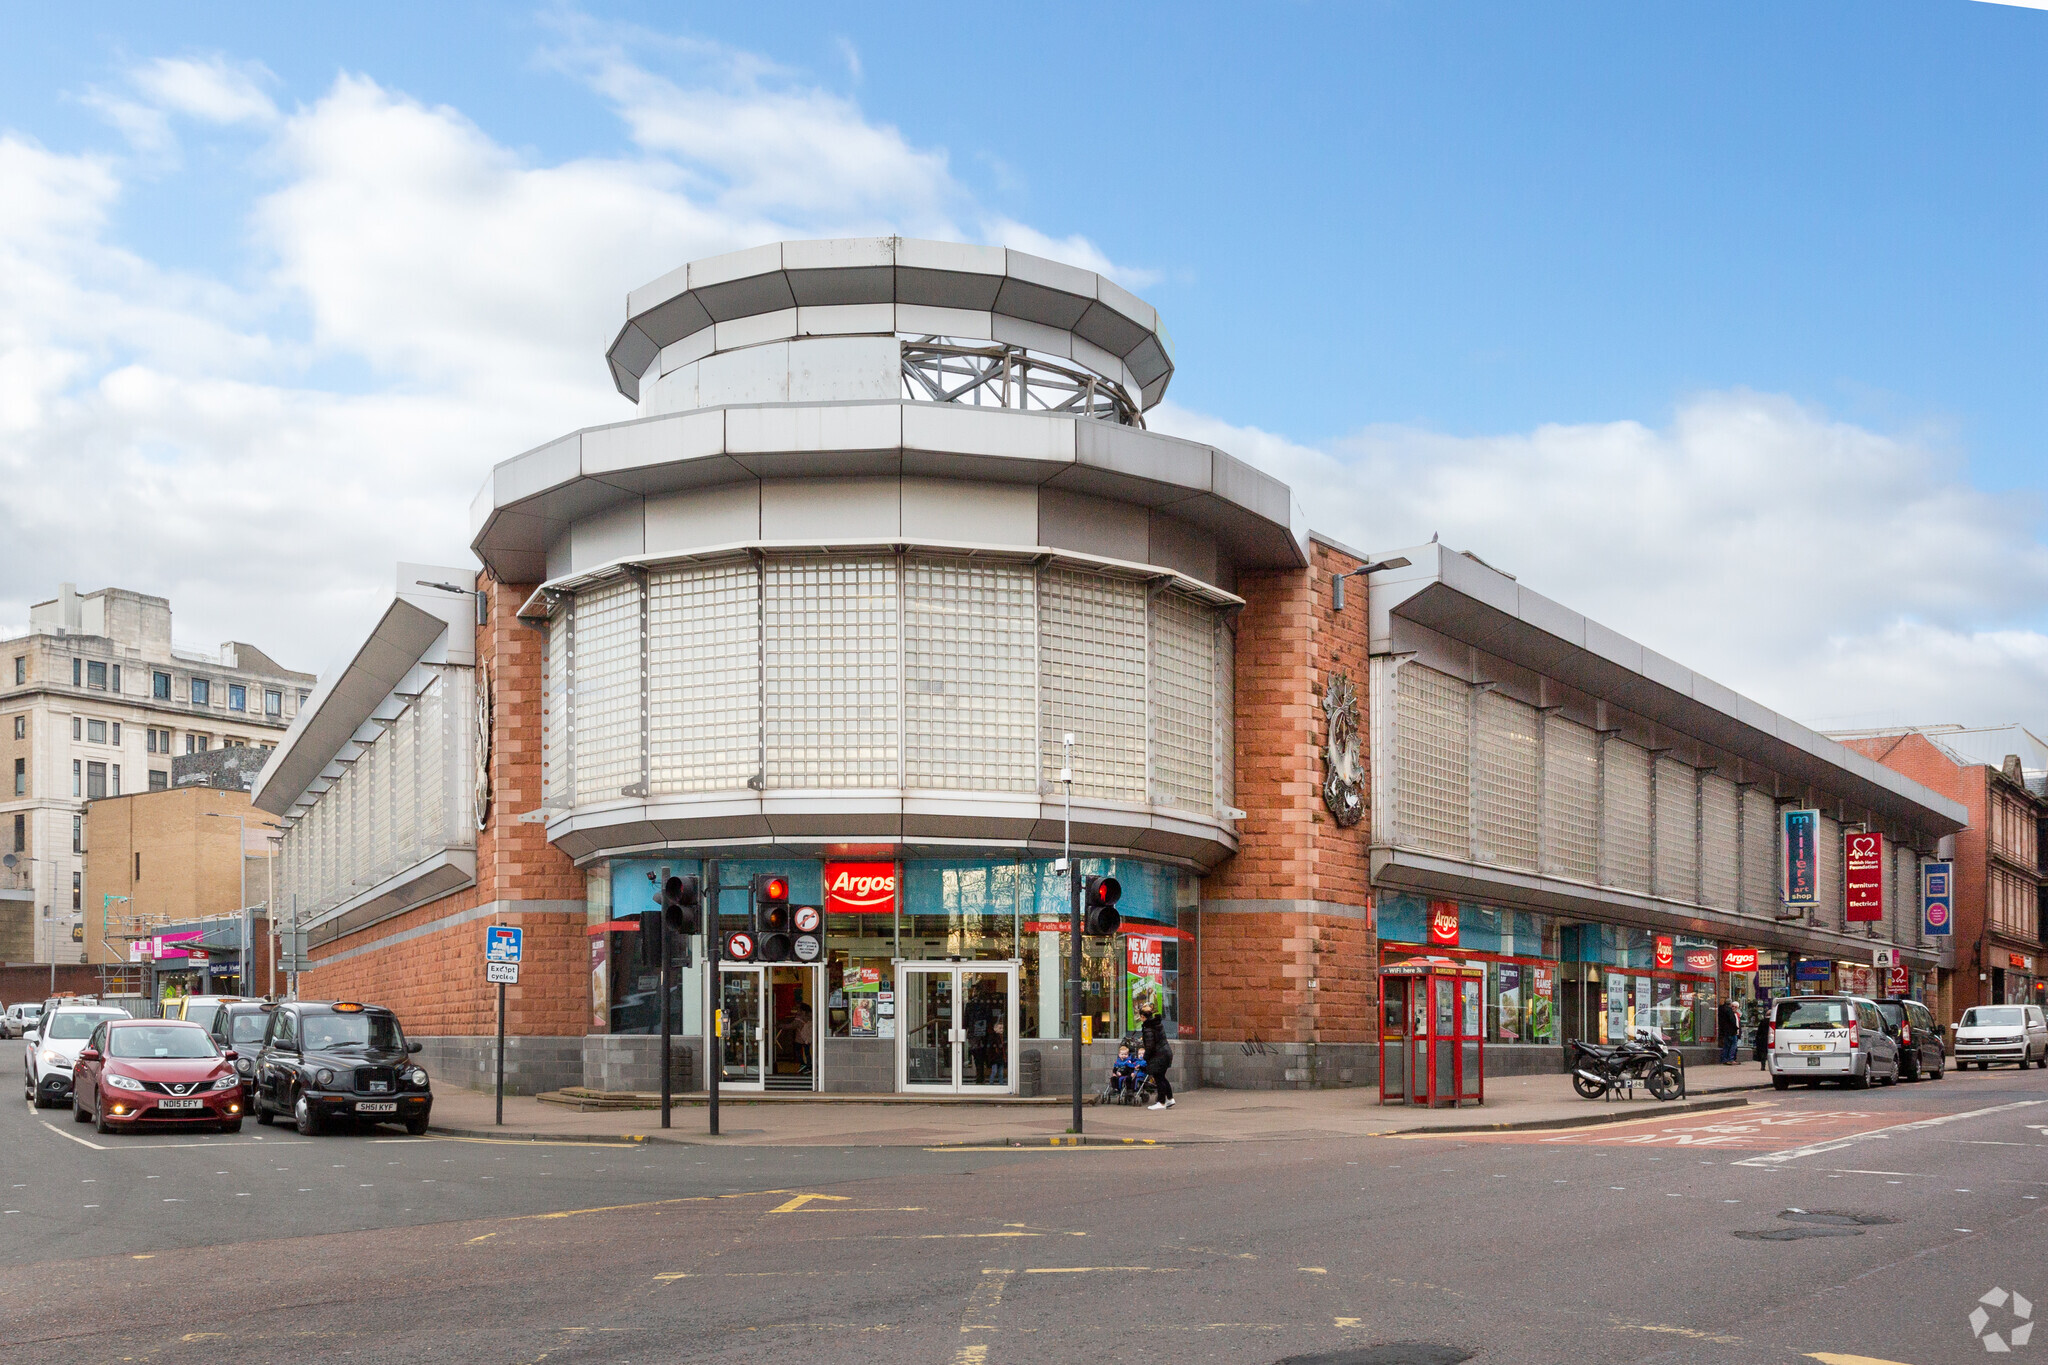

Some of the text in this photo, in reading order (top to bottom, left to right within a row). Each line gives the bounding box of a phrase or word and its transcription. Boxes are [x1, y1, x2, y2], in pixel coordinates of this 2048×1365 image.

[831, 871, 895, 897] Argos
[1433, 910, 1458, 932] Argos
[1128, 938, 1149, 952] NEW
[1657, 941, 1672, 959] Argos
[1132, 951, 1161, 967] RANGE
[1724, 953, 1755, 965] Argos
[1137, 965, 1160, 974] OUT NOW
[1538, 1134, 1781, 1147] LANE
